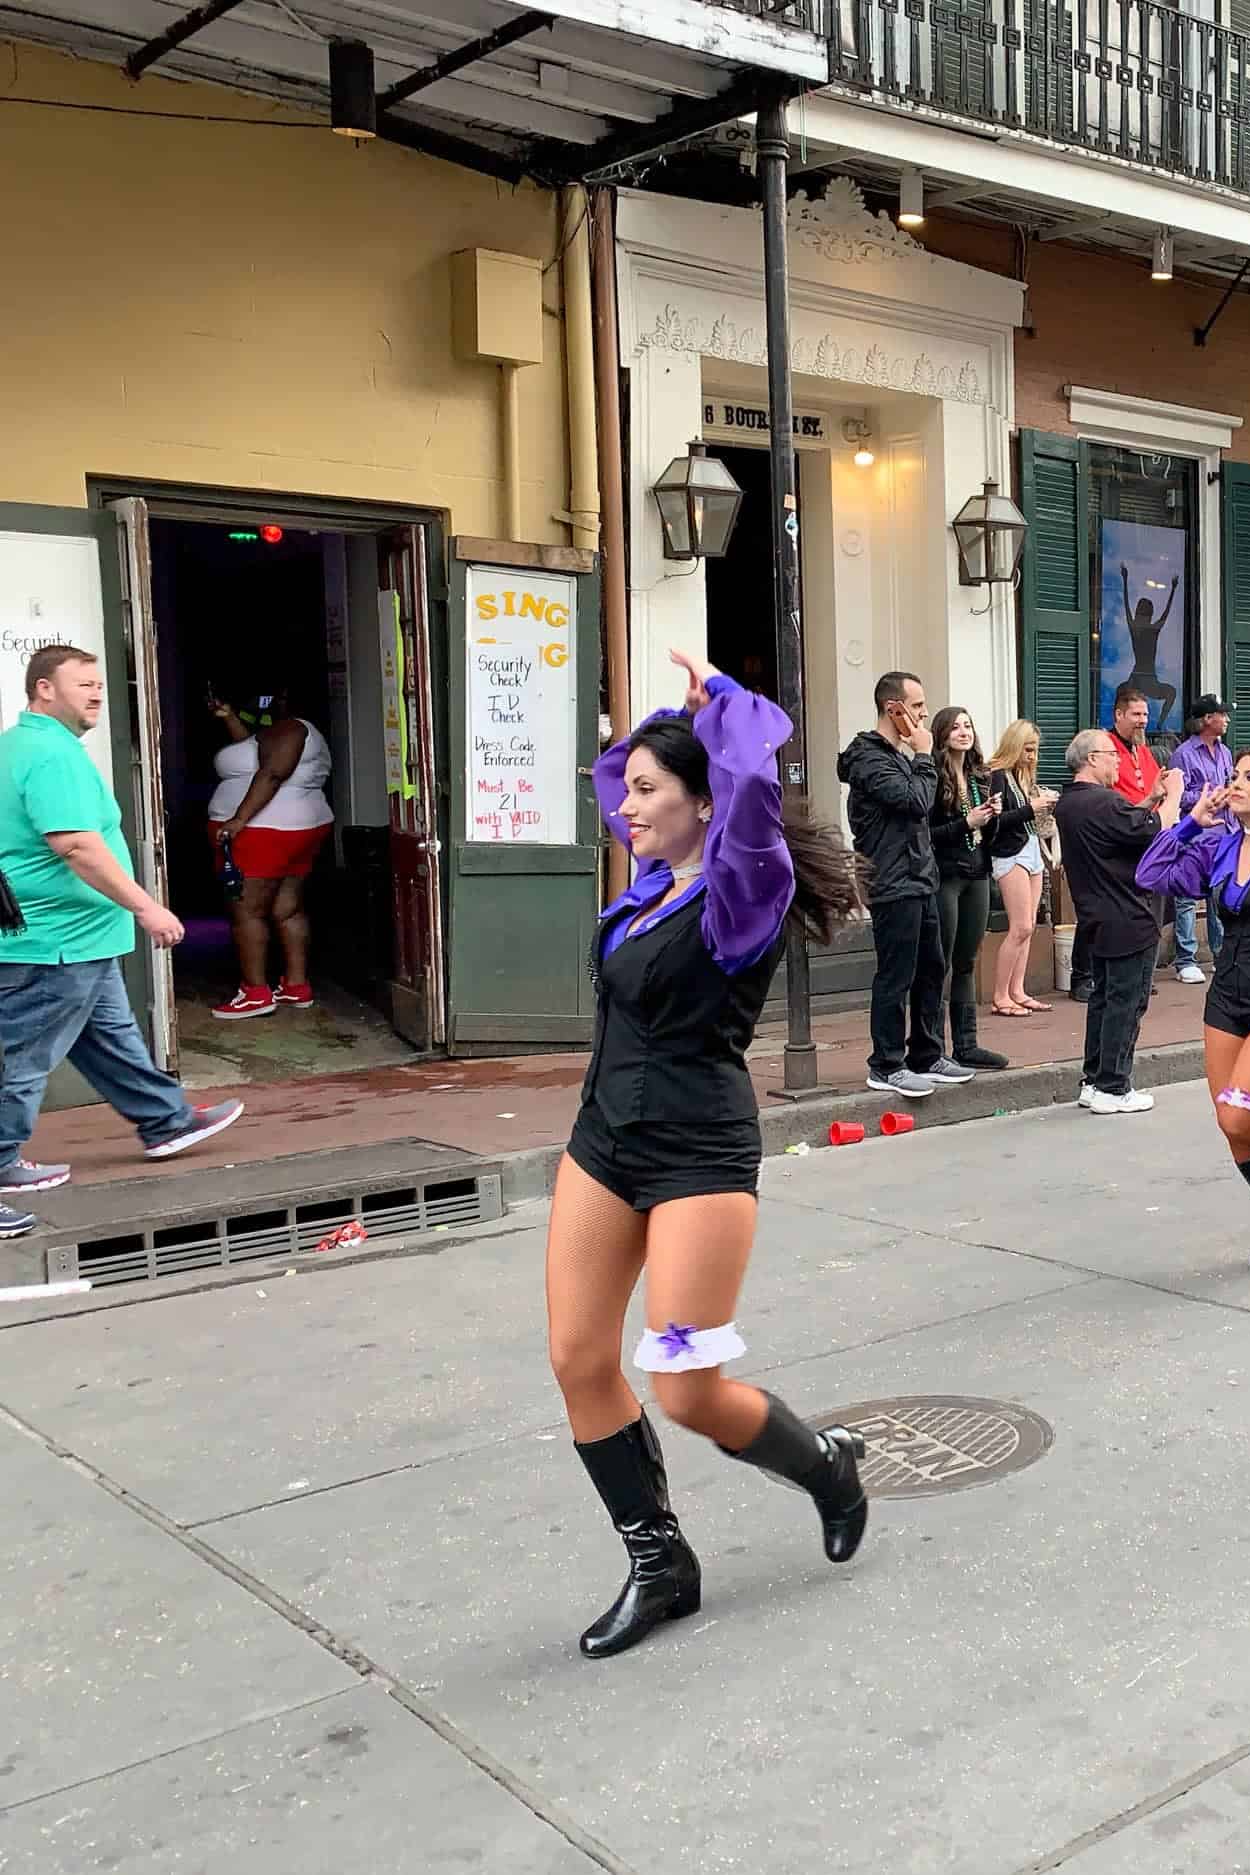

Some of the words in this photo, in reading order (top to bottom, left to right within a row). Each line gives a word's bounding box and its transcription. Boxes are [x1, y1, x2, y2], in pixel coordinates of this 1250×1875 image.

[475, 591, 570, 628] SING
[479, 655, 531, 681] Security
[490, 673, 522, 687] Check
[491, 711, 524, 723] Check
[475, 735, 503, 752] Dress
[510, 735, 537, 752] Code
[484, 752, 534, 766] Enforced
[478, 779, 504, 793] Must
[518, 779, 534, 793] Be
[499, 793, 517, 810] 21
[475, 811, 502, 825] with
[509, 809, 543, 825] VALID
